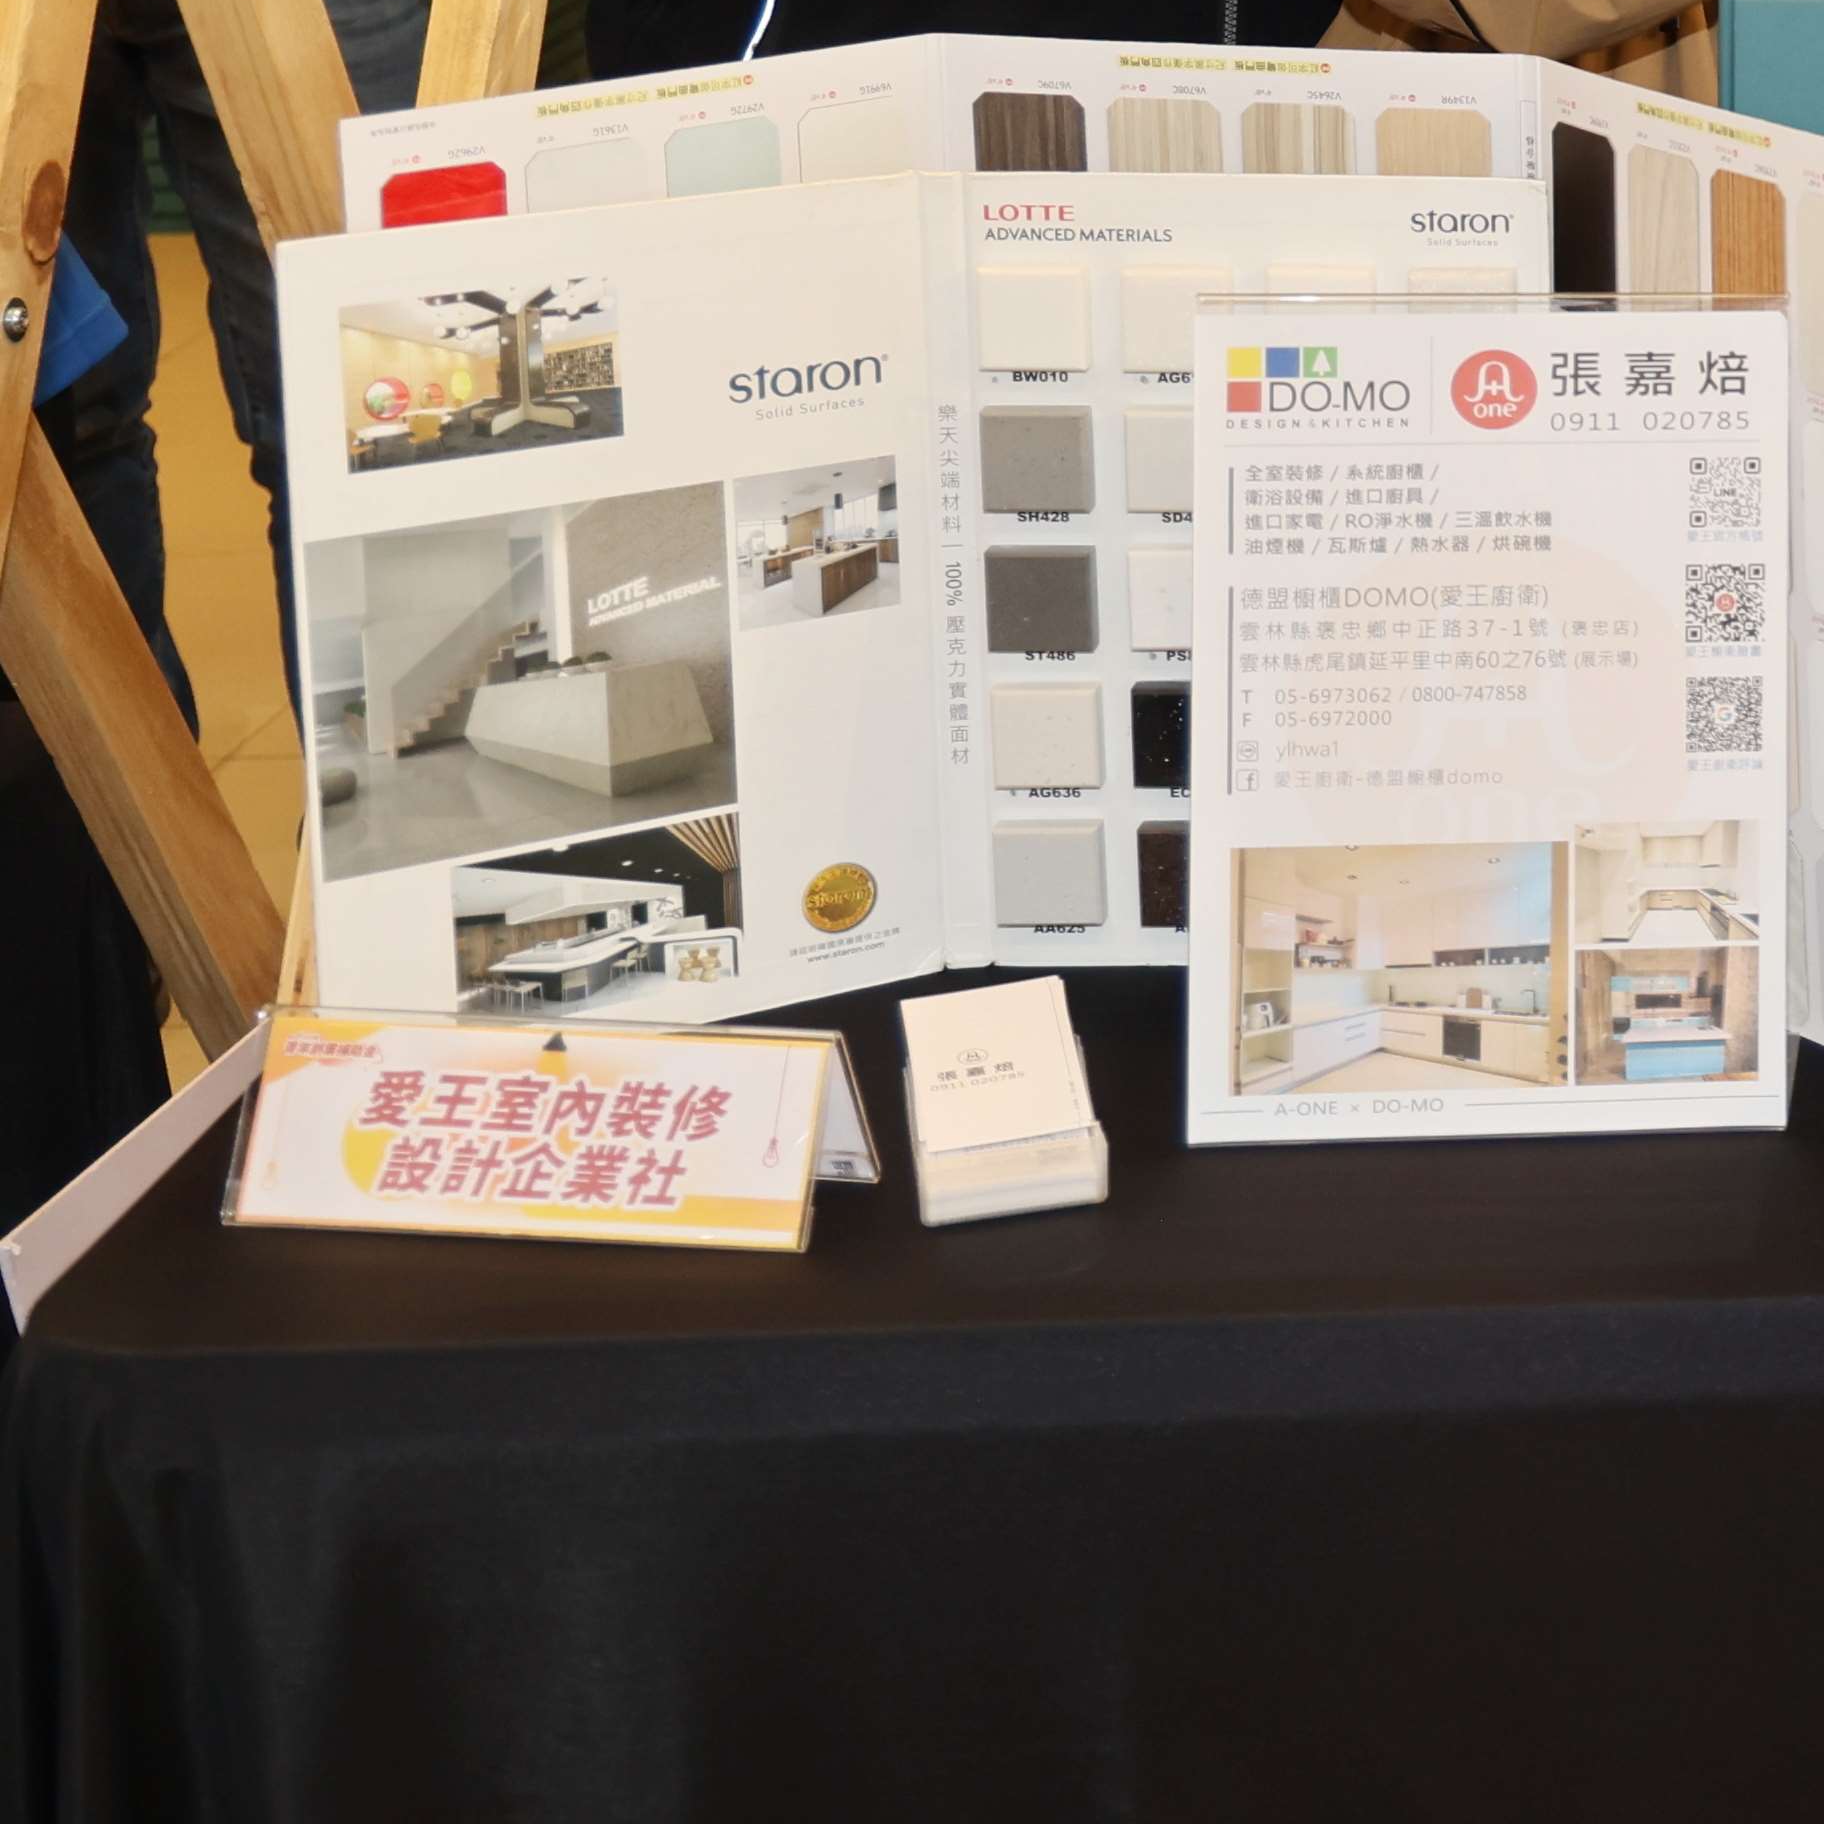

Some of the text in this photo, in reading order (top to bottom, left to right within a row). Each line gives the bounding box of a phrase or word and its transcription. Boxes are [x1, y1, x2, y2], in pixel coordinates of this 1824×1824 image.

[983, 204, 1075, 222] LOTTE
[1411, 210, 1510, 234] staron
[985, 227, 1173, 243] ADVANCED MATERIALS
[1426, 237, 1498, 247] Solid Surfaces
[729, 356, 882, 404] staron
[1012, 371, 1068, 382] BW010
[1158, 372, 1193, 383] AG6
[1551, 352, 1750, 397] 張嘉焙
[1269, 380, 1410, 412] DO-MO
[755, 398, 864, 421] Solid Surfaces
[1473, 401, 1518, 418] one
[1226, 419, 1301, 429] DESIGN
[1323, 418, 1409, 428] KITCHEN
[1551, 411, 1750, 432] 0911 020785
[1245, 465, 1323, 482] 全室裝修
[1245, 489, 1323, 506] 衛浴設備
[1346, 488, 1423, 504] 進口廚具
[1713, 488, 1737, 497] LINE
[1017, 511, 1070, 523] SH428
[1245, 513, 1323, 530] 進口家電
[1345, 512, 1433, 529] RO淨水機
[1455, 510, 1552, 528] 三溫飲水機
[1245, 537, 1305, 555] 油煙機
[1328, 537, 1387, 554] 瓦斯爐
[1411, 535, 1470, 553] 熱水器
[1492, 535, 1552, 552] 烘碗機
[938, 404, 970, 765] 樂天尖端材料 100% 壓克力實體面材
[587, 576, 648, 615] LOTTE
[1025, 650, 1076, 662] ST486
[1573, 651, 1639, 670] (展示場)
[1241, 690, 1254, 705] T
[1274, 688, 1392, 705] 05-6973062
[1411, 685, 1528, 703] 0800-747858
[1242, 710, 1392, 727] F 05-6972000
[1029, 788, 1081, 798] AG636
[808, 942, 885, 963] www.staron.com
[359, 1070, 731, 1142] 愛王室內裝修
[1274, 1101, 1338, 1117] A-ONE
[1372, 1098, 1444, 1114] DO-MO
[377, 1137, 688, 1207] 設計企業社
